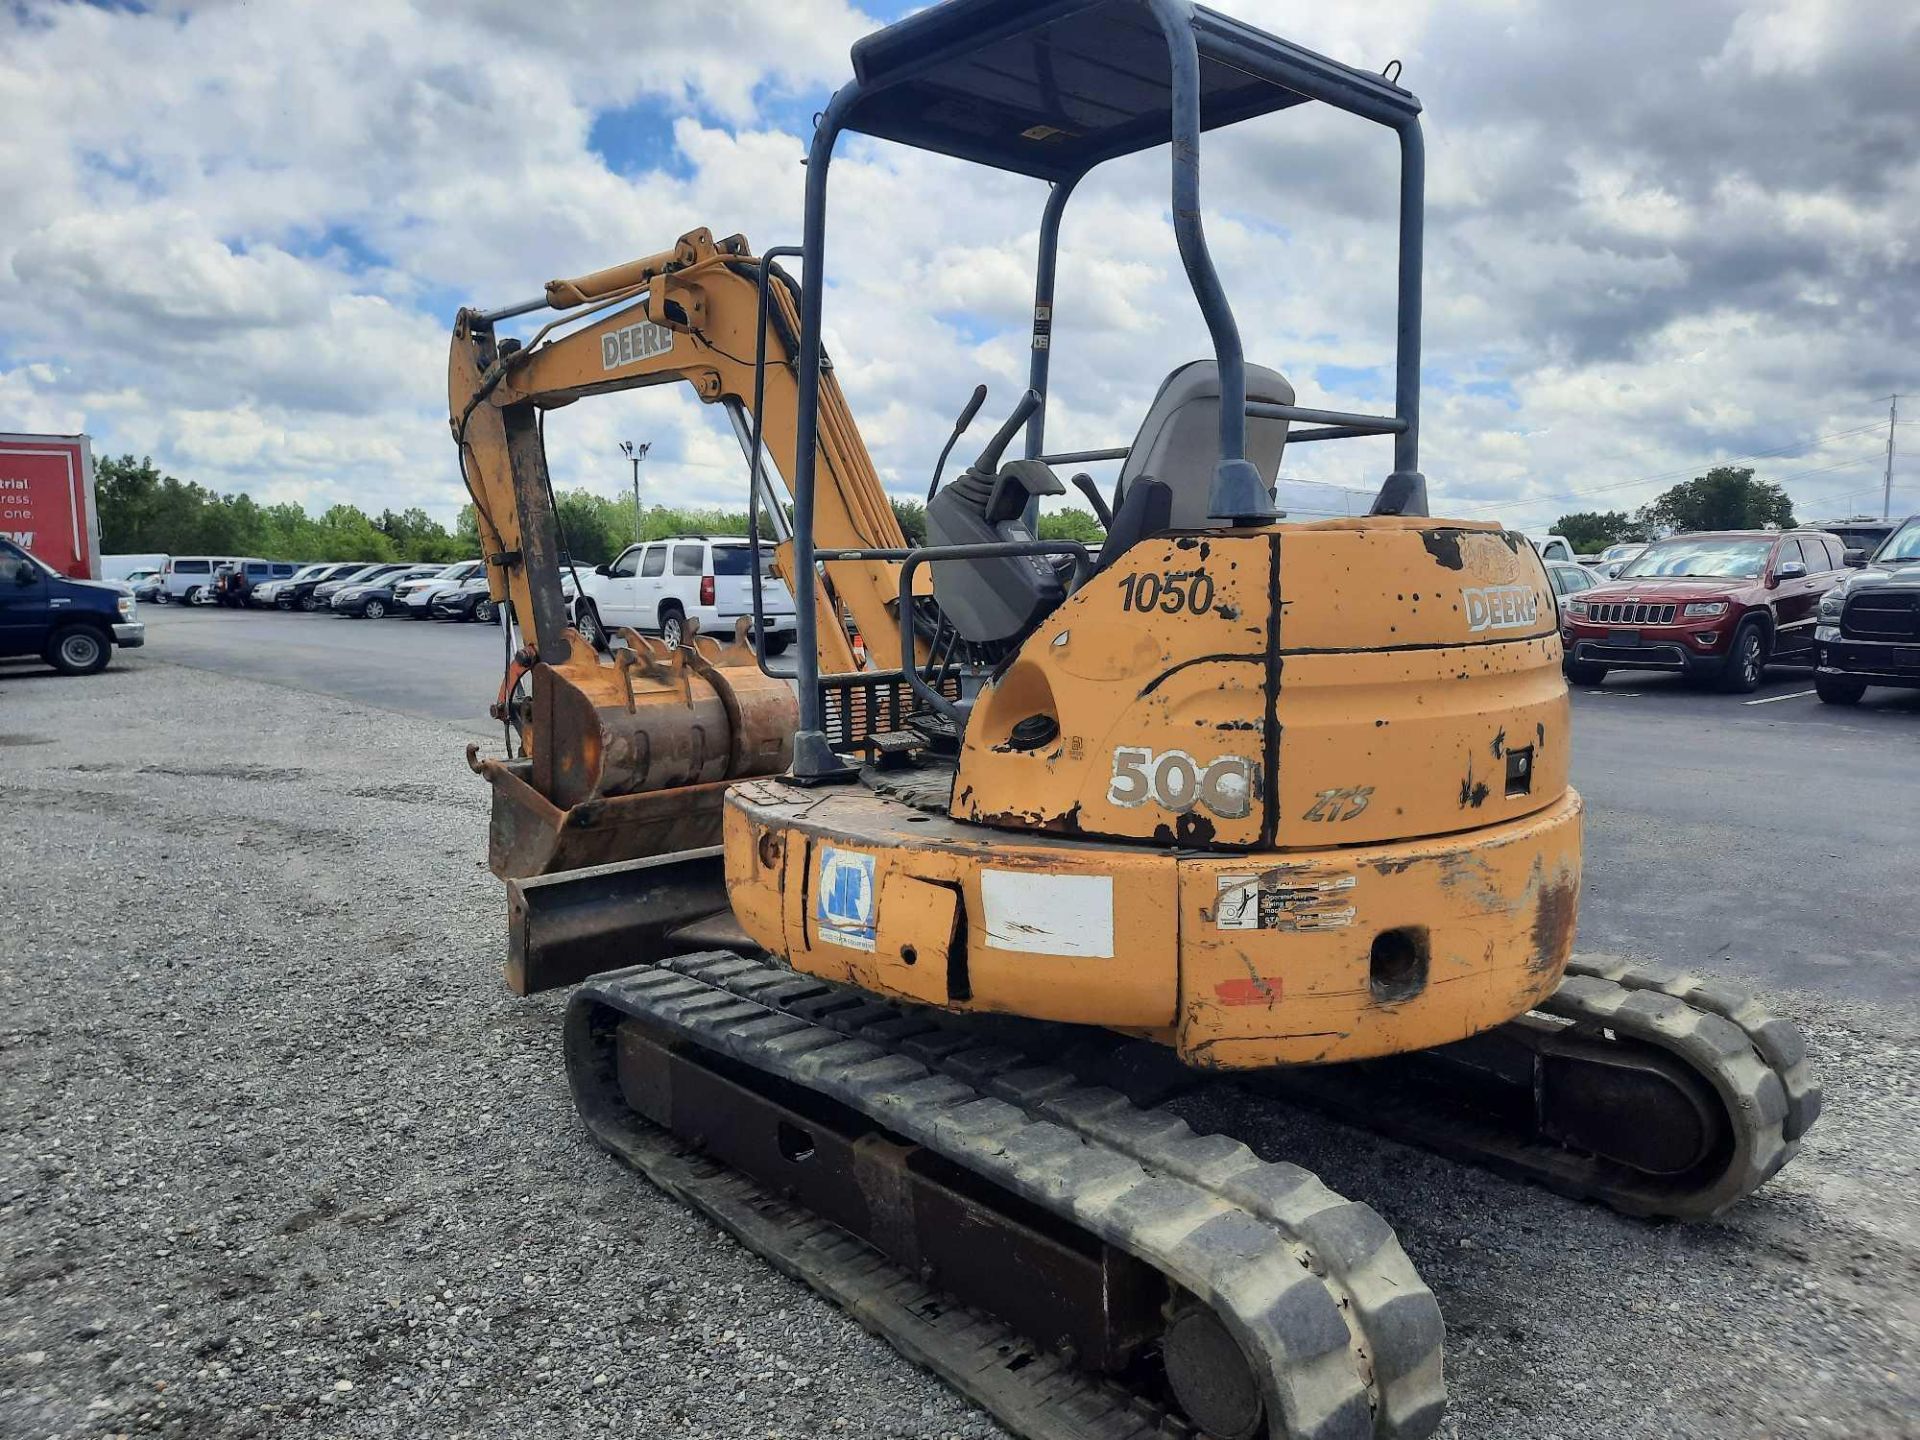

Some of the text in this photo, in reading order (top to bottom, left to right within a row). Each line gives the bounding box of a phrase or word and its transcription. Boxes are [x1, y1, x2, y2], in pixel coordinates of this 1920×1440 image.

[602, 321, 673, 369] DEERE
[1118, 572, 1215, 616] 1050
[1463, 586, 1537, 631] DEERE
[1107, 748, 1250, 829] 50C
